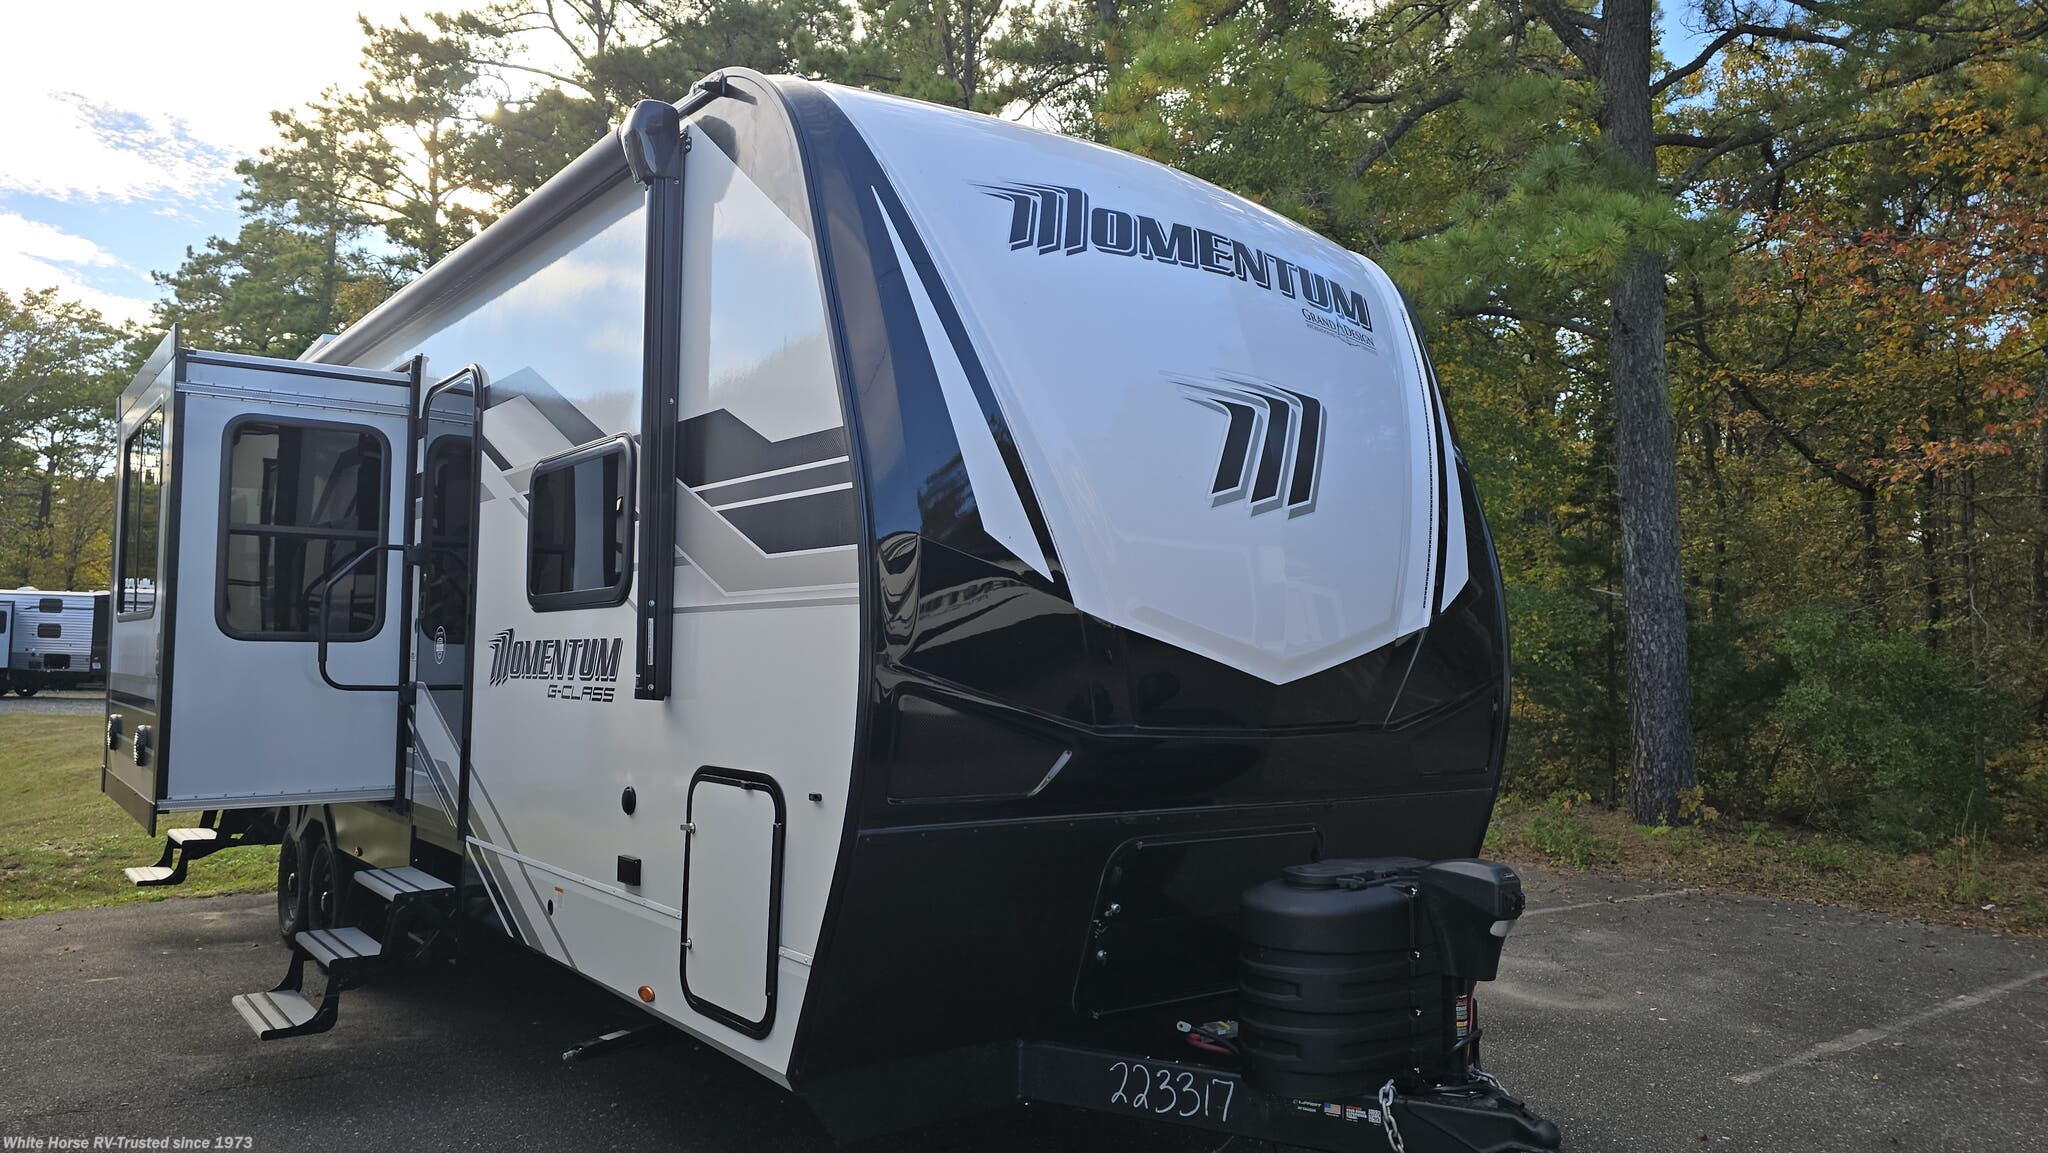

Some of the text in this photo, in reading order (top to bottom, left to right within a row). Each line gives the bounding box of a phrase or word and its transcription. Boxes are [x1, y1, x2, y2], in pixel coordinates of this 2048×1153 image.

[972, 180, 1373, 333] MOMENTUM
[1301, 308, 1337, 331] GRAND
[1342, 324, 1376, 348] DESIGN
[489, 627, 624, 687] MOMENTUM
[547, 684, 616, 703] G-CLASS
[1109, 1061, 1235, 1122] 223317
